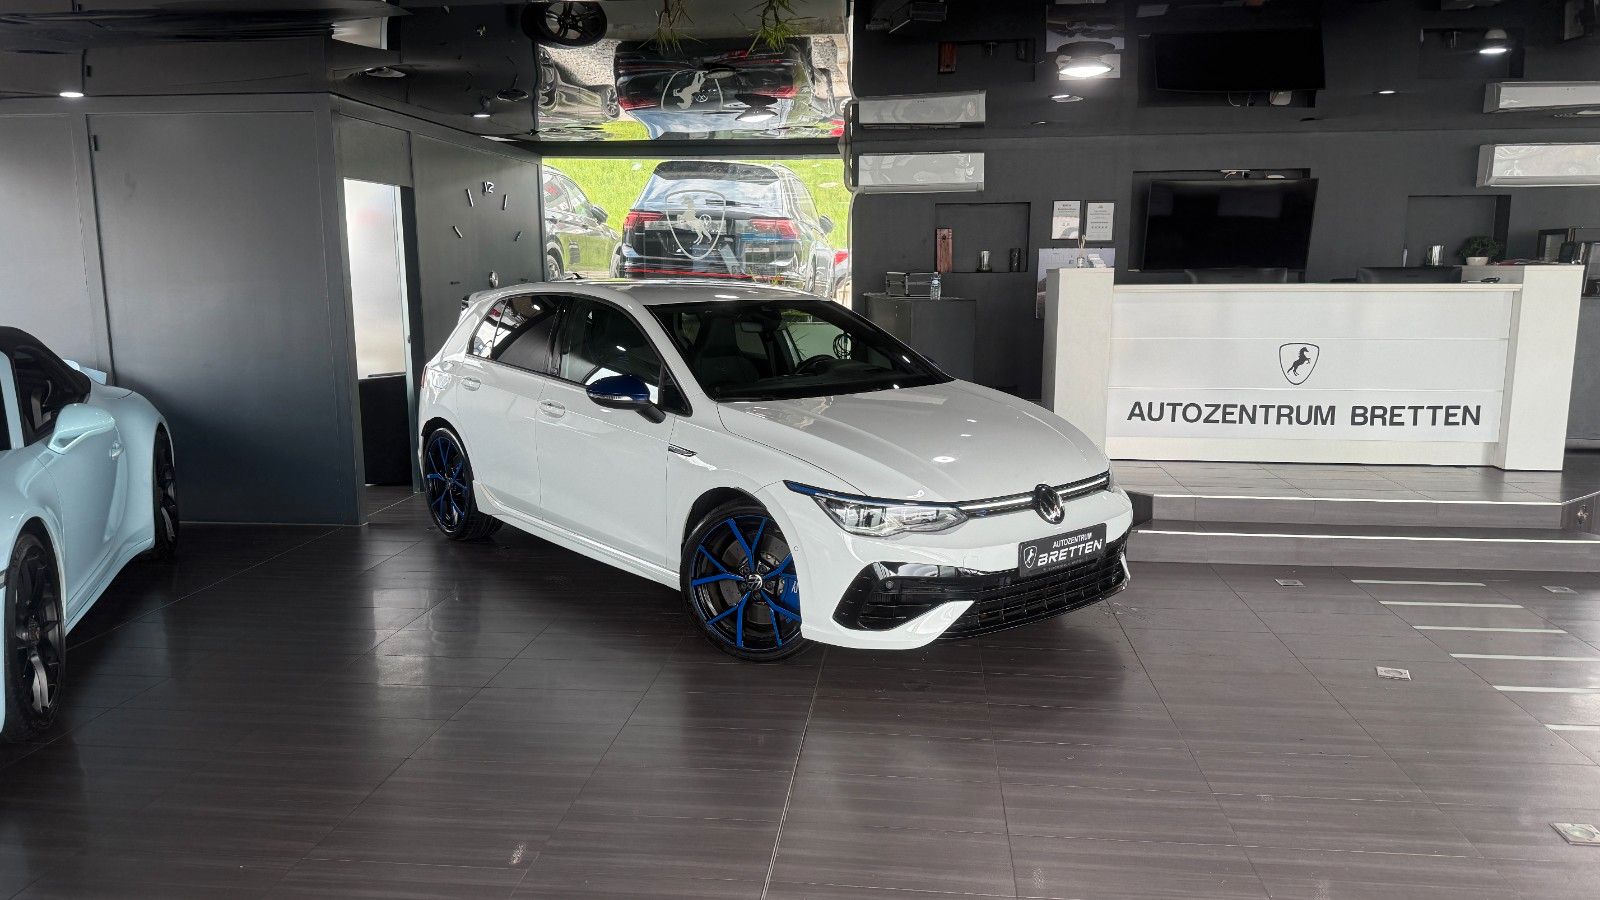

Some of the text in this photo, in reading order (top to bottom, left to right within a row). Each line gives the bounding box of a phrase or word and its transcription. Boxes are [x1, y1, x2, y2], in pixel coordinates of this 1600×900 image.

[484, 181, 495, 193] 12
[1127, 401, 1482, 426] AUTOZENTRUM BRETTEN
[1052, 532, 1093, 549] AUTOZENTRUM
[1037, 539, 1103, 566] BRETTEN
